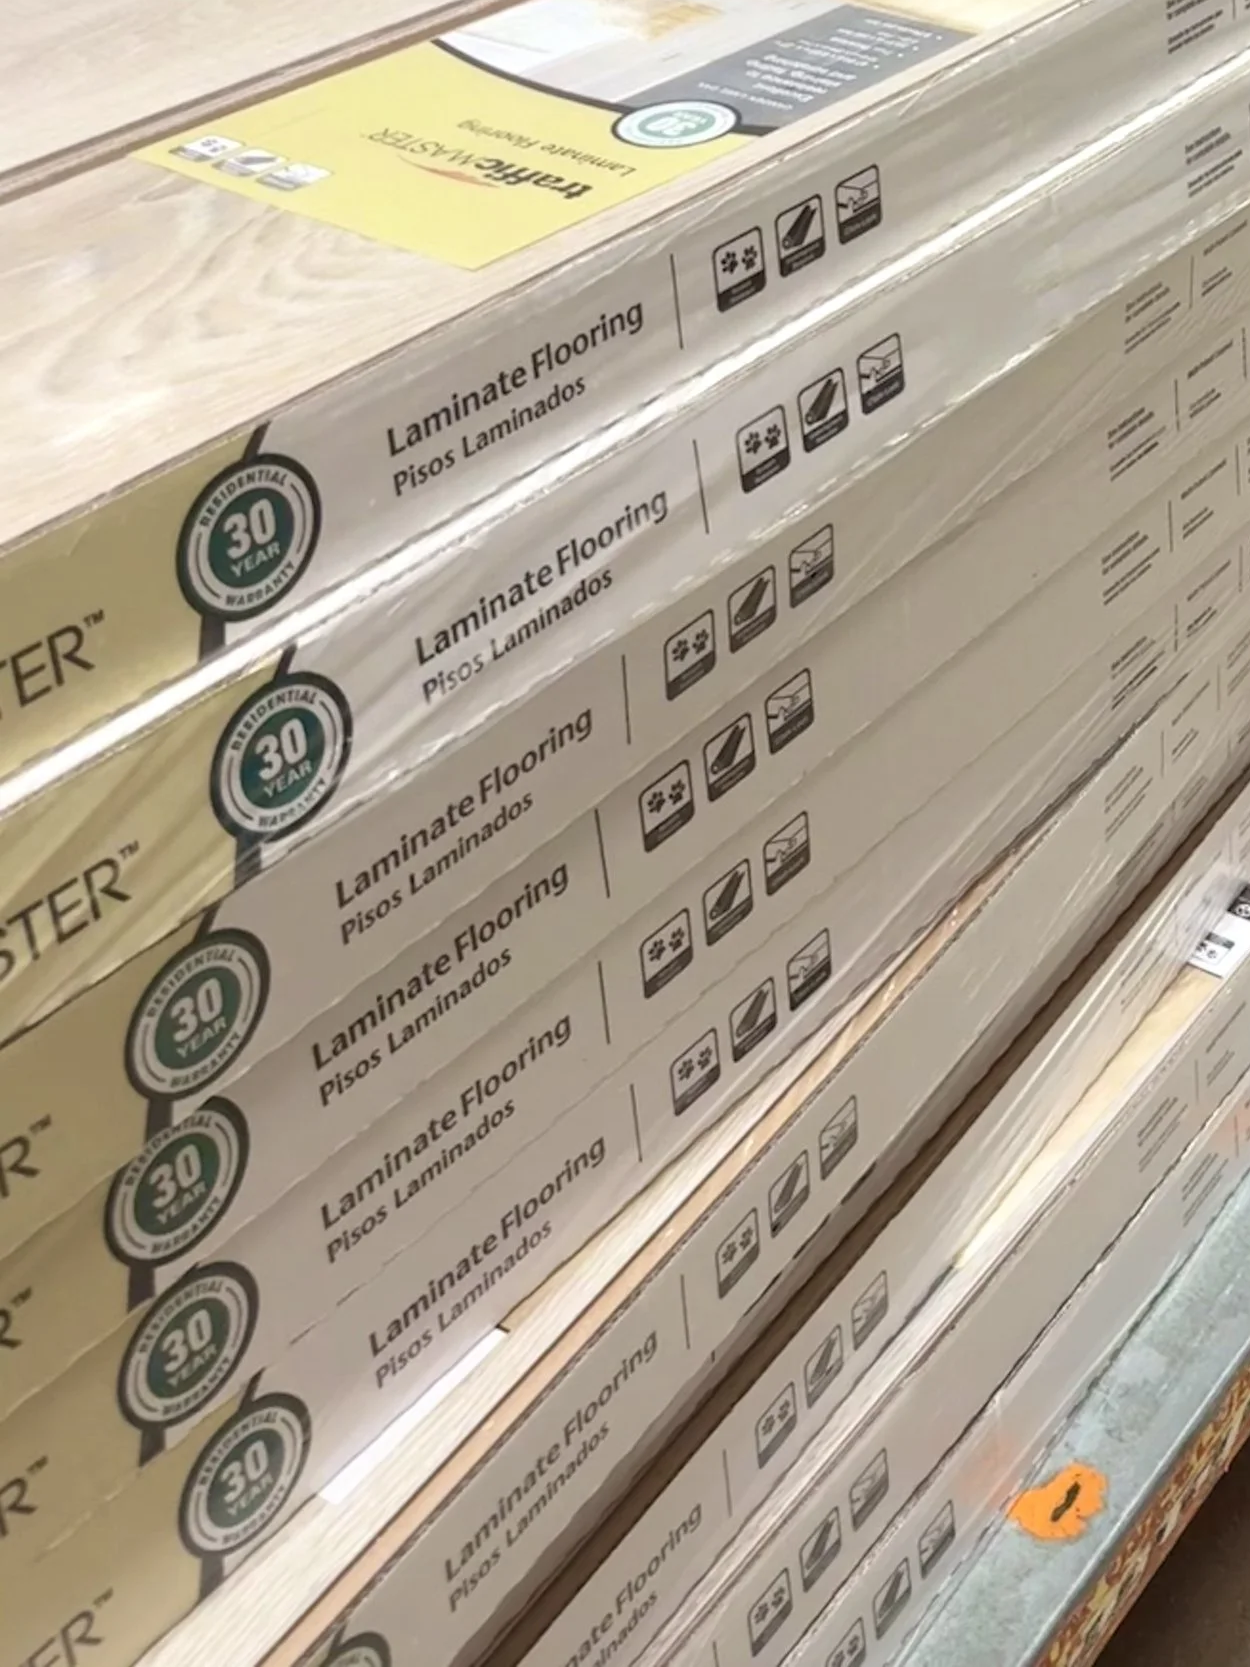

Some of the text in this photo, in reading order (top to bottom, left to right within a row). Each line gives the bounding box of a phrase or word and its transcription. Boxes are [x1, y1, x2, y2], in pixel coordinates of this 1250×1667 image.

[456, 118, 637, 178] Laminate Flooring
[645, 116, 698, 137] 30
[385, 299, 646, 458] Laminate Flooring
[391, 374, 588, 499] Pisos Laminados
[223, 500, 277, 560] 30
[228, 543, 284, 581] YEAR
[223, 561, 298, 613] WARRANTY
[413, 485, 669, 666] Laminate Flooring
[422, 568, 615, 706] Pisos Laminados
[254, 716, 308, 781] 30
[262, 759, 314, 799] YEAR
[258, 776, 328, 829] WARRANTY
[335, 707, 596, 910] Laminate Flooring
[340, 791, 535, 945] Pisos Laminados
[310, 861, 570, 1072] Laminate Flooring
[169, 976, 226, 1044] 30
[175, 1015, 228, 1059] YEAR
[317, 945, 514, 1108] Pisos Laminados
[318, 1015, 573, 1232] Laminate Flooring
[149, 1143, 202, 1210] 30
[155, 1180, 208, 1227] YEAR
[325, 1098, 518, 1265] Pisos Laminados
[368, 1135, 608, 1358] Laminate Flooring
[374, 1218, 554, 1390] Pisos Laminados
[160, 1307, 215, 1373] 30
[165, 1344, 218, 1389] YEAR
[219, 1439, 271, 1504] 30
[443, 1329, 660, 1584] Laminate Flooring
[226, 1473, 275, 1518] YEAR
[448, 1422, 611, 1614] Pisos Laminados
[614, 1503, 702, 1616] Flooring
